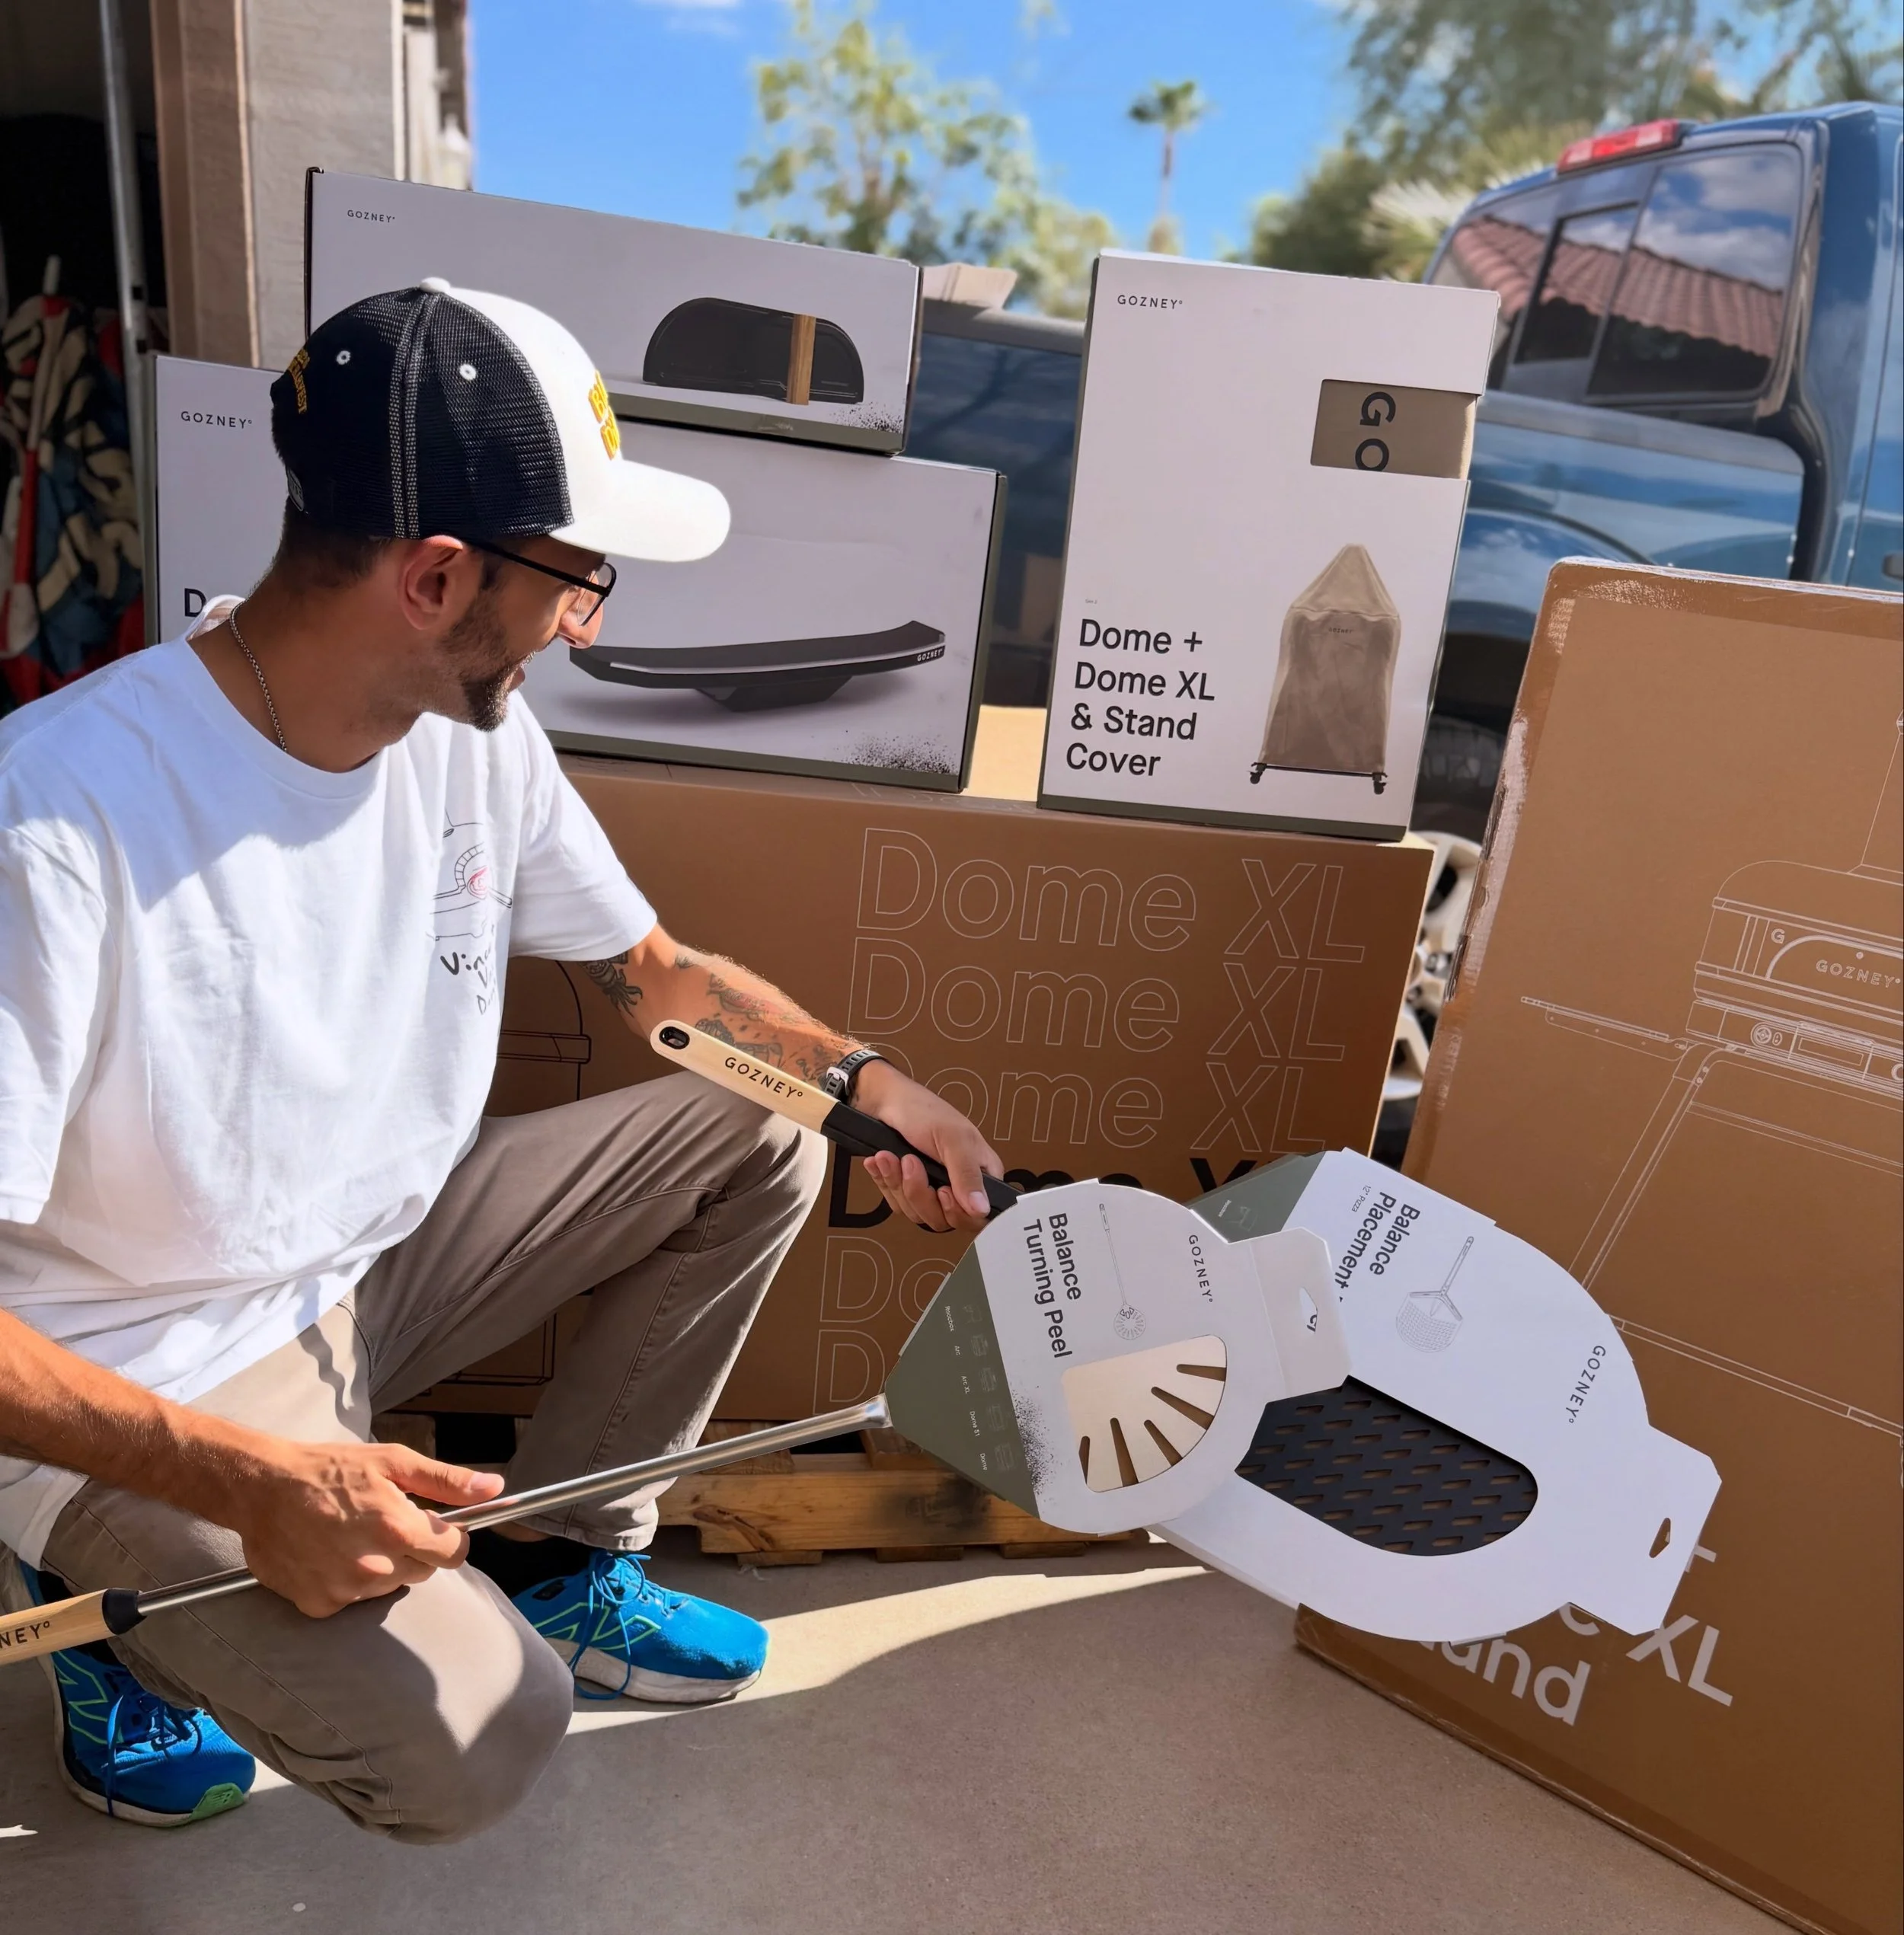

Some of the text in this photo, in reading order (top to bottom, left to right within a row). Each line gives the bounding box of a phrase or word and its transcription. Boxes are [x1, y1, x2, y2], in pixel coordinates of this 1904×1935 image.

[1075, 661, 1215, 701] Dome XL
[1079, 618, 1203, 654] Dome +
[1066, 742, 1161, 776] Cover
[1071, 702, 1197, 740] & Stand
[856, 827, 1366, 963] Dome XL
[847, 937, 1347, 1062] Dome XL
[864, 1042, 1327, 1152] ome XL
[1049, 1212, 1081, 1301] Balance
[1334, 1191, 1397, 1289] Placement
[1369, 1203, 1421, 1276] Balance
[1024, 1218, 1073, 1359] Turning Peel
[1625, 1614, 1733, 1707] XL
